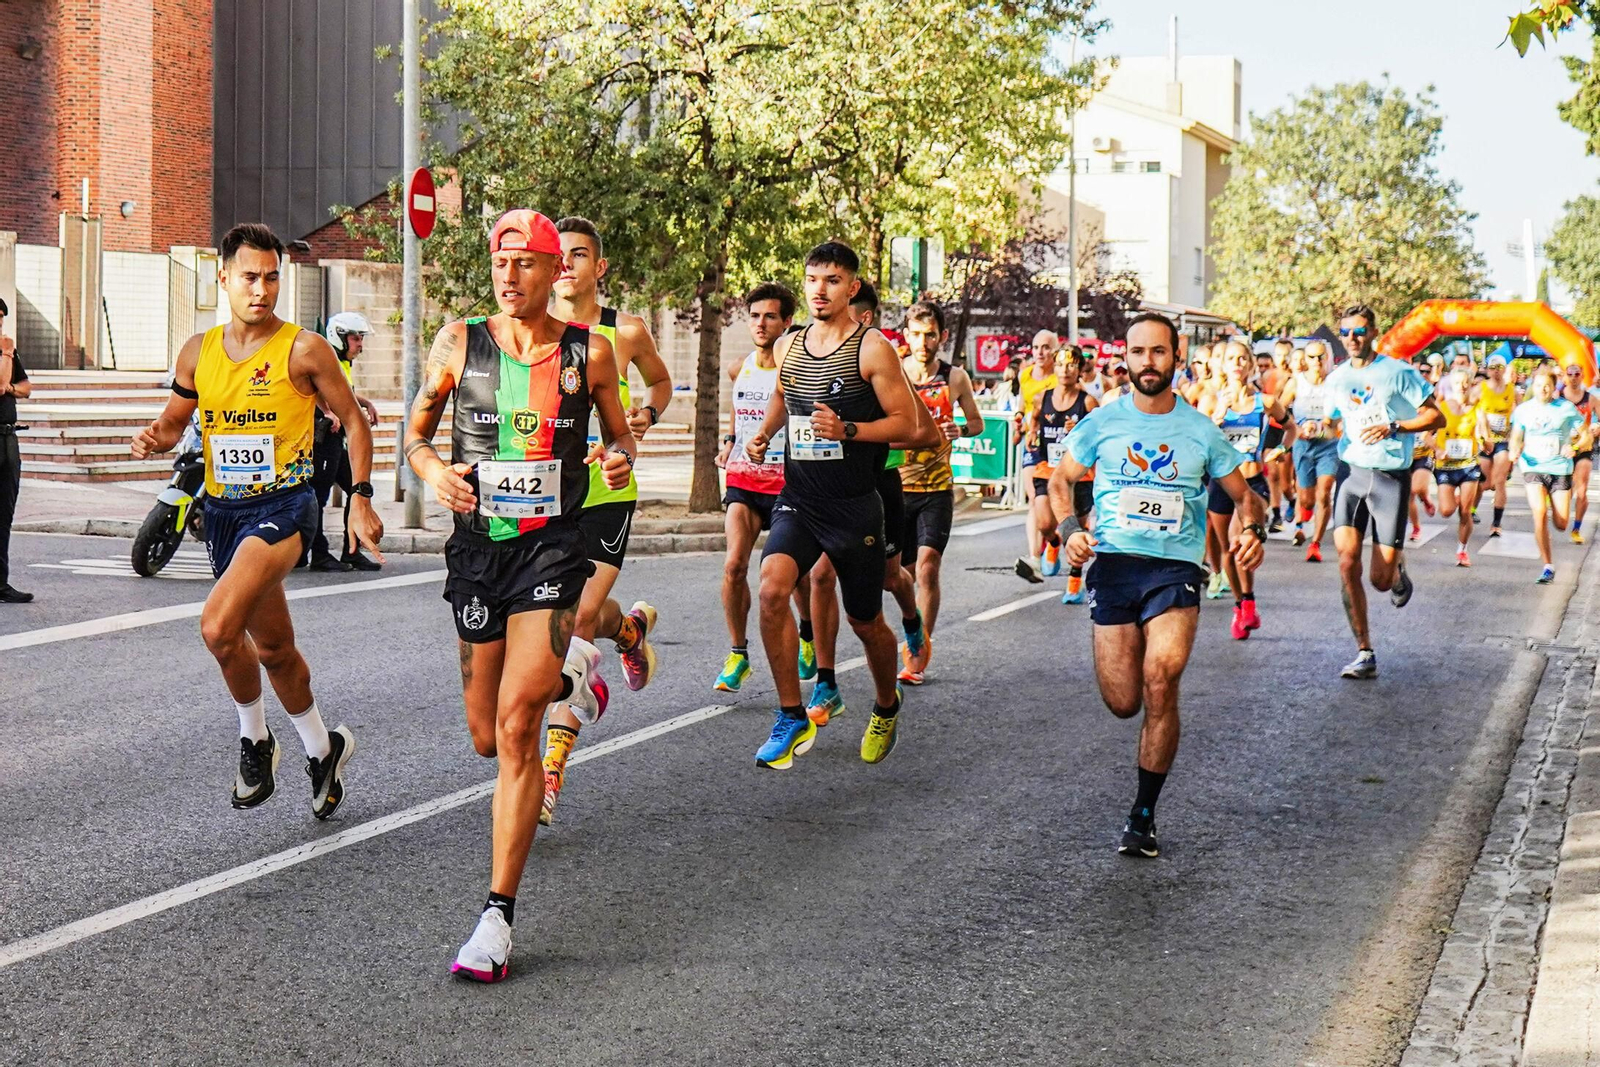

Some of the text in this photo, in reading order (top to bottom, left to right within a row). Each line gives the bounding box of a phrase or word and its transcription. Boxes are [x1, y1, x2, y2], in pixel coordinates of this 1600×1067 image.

[222, 409, 277, 426] Vigilsa
[473, 411, 506, 425] LOKI
[737, 408, 765, 416] GRAN
[546, 417, 575, 428] TEST
[219, 448, 265, 464] 1330
[497, 477, 542, 495] 442
[1138, 501, 1162, 516] 28
